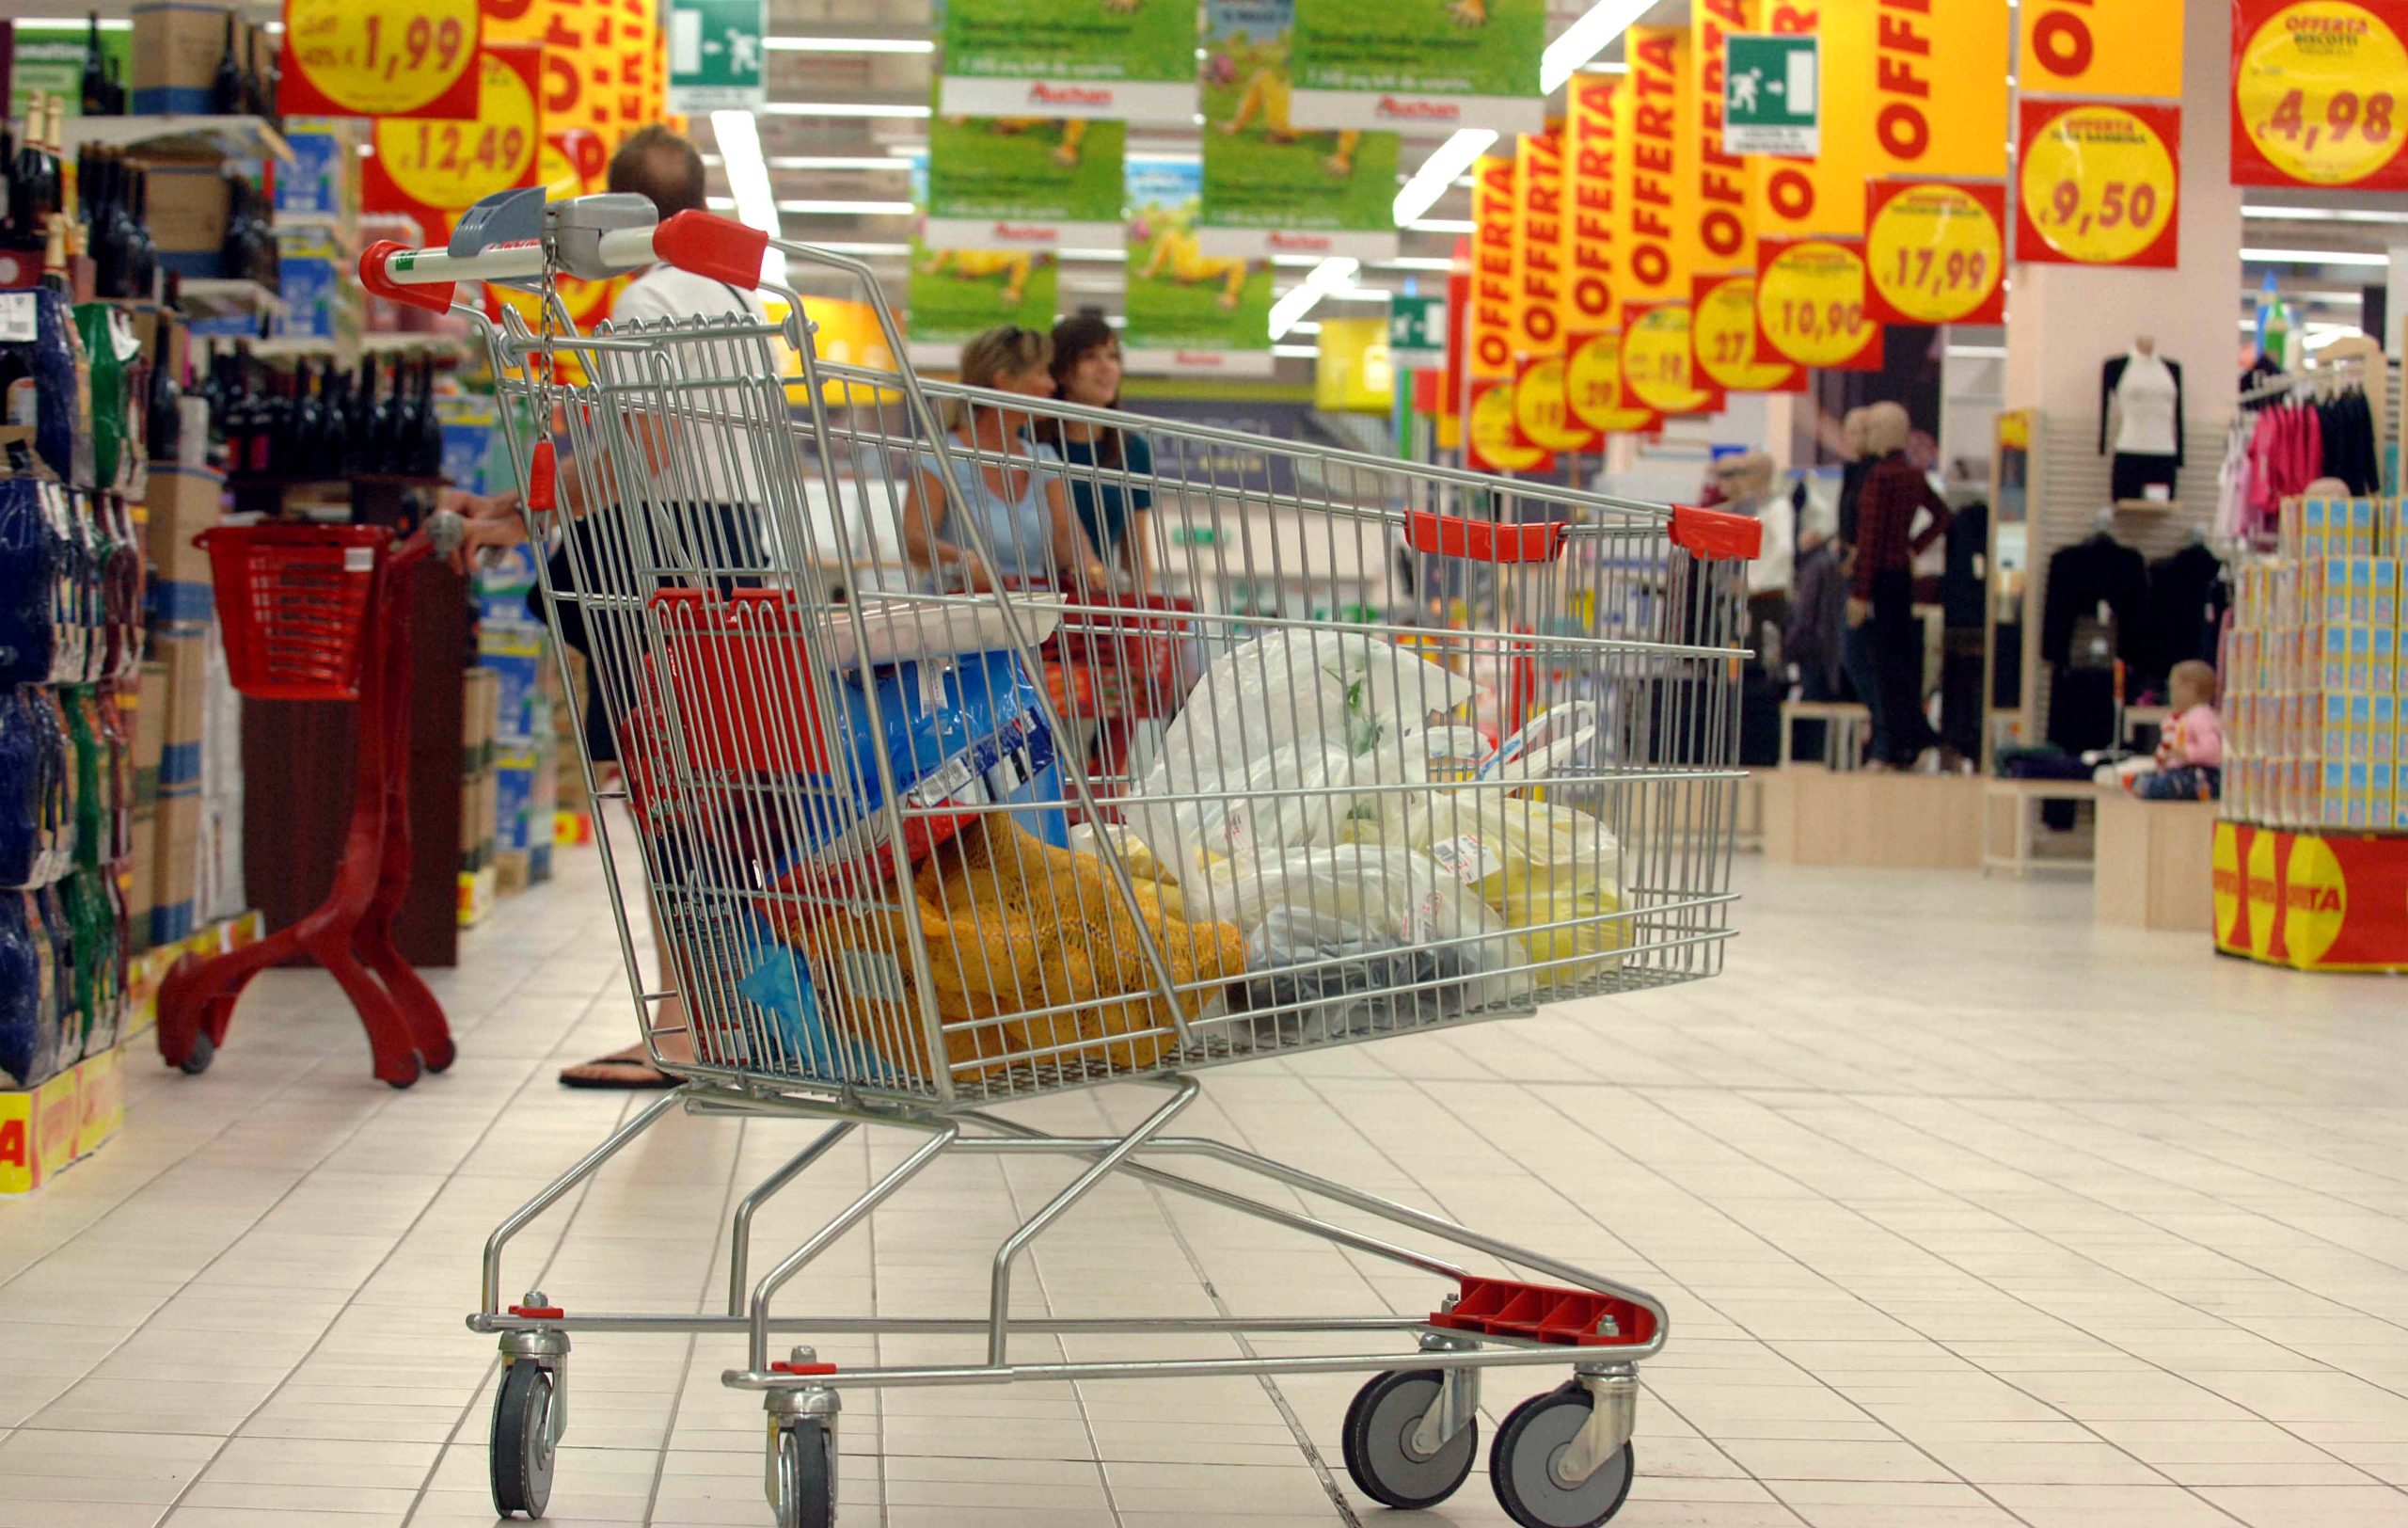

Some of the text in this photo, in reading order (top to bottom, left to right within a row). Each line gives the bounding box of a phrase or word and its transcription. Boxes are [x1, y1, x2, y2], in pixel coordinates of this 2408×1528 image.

[364, 15, 464, 82] 1,99
[416, 125, 524, 180] 12,49
[2270, 88, 2396, 151] 4,98
[1631, 36, 1677, 288] OFFERTA
[1574, 84, 1616, 317] OFFERTA
[2053, 179, 2157, 237] 9,50
[1478, 163, 1514, 367] OFFERTA
[1523, 127, 1562, 342] OFFERTA
[1896, 247, 1988, 298] 17,99
